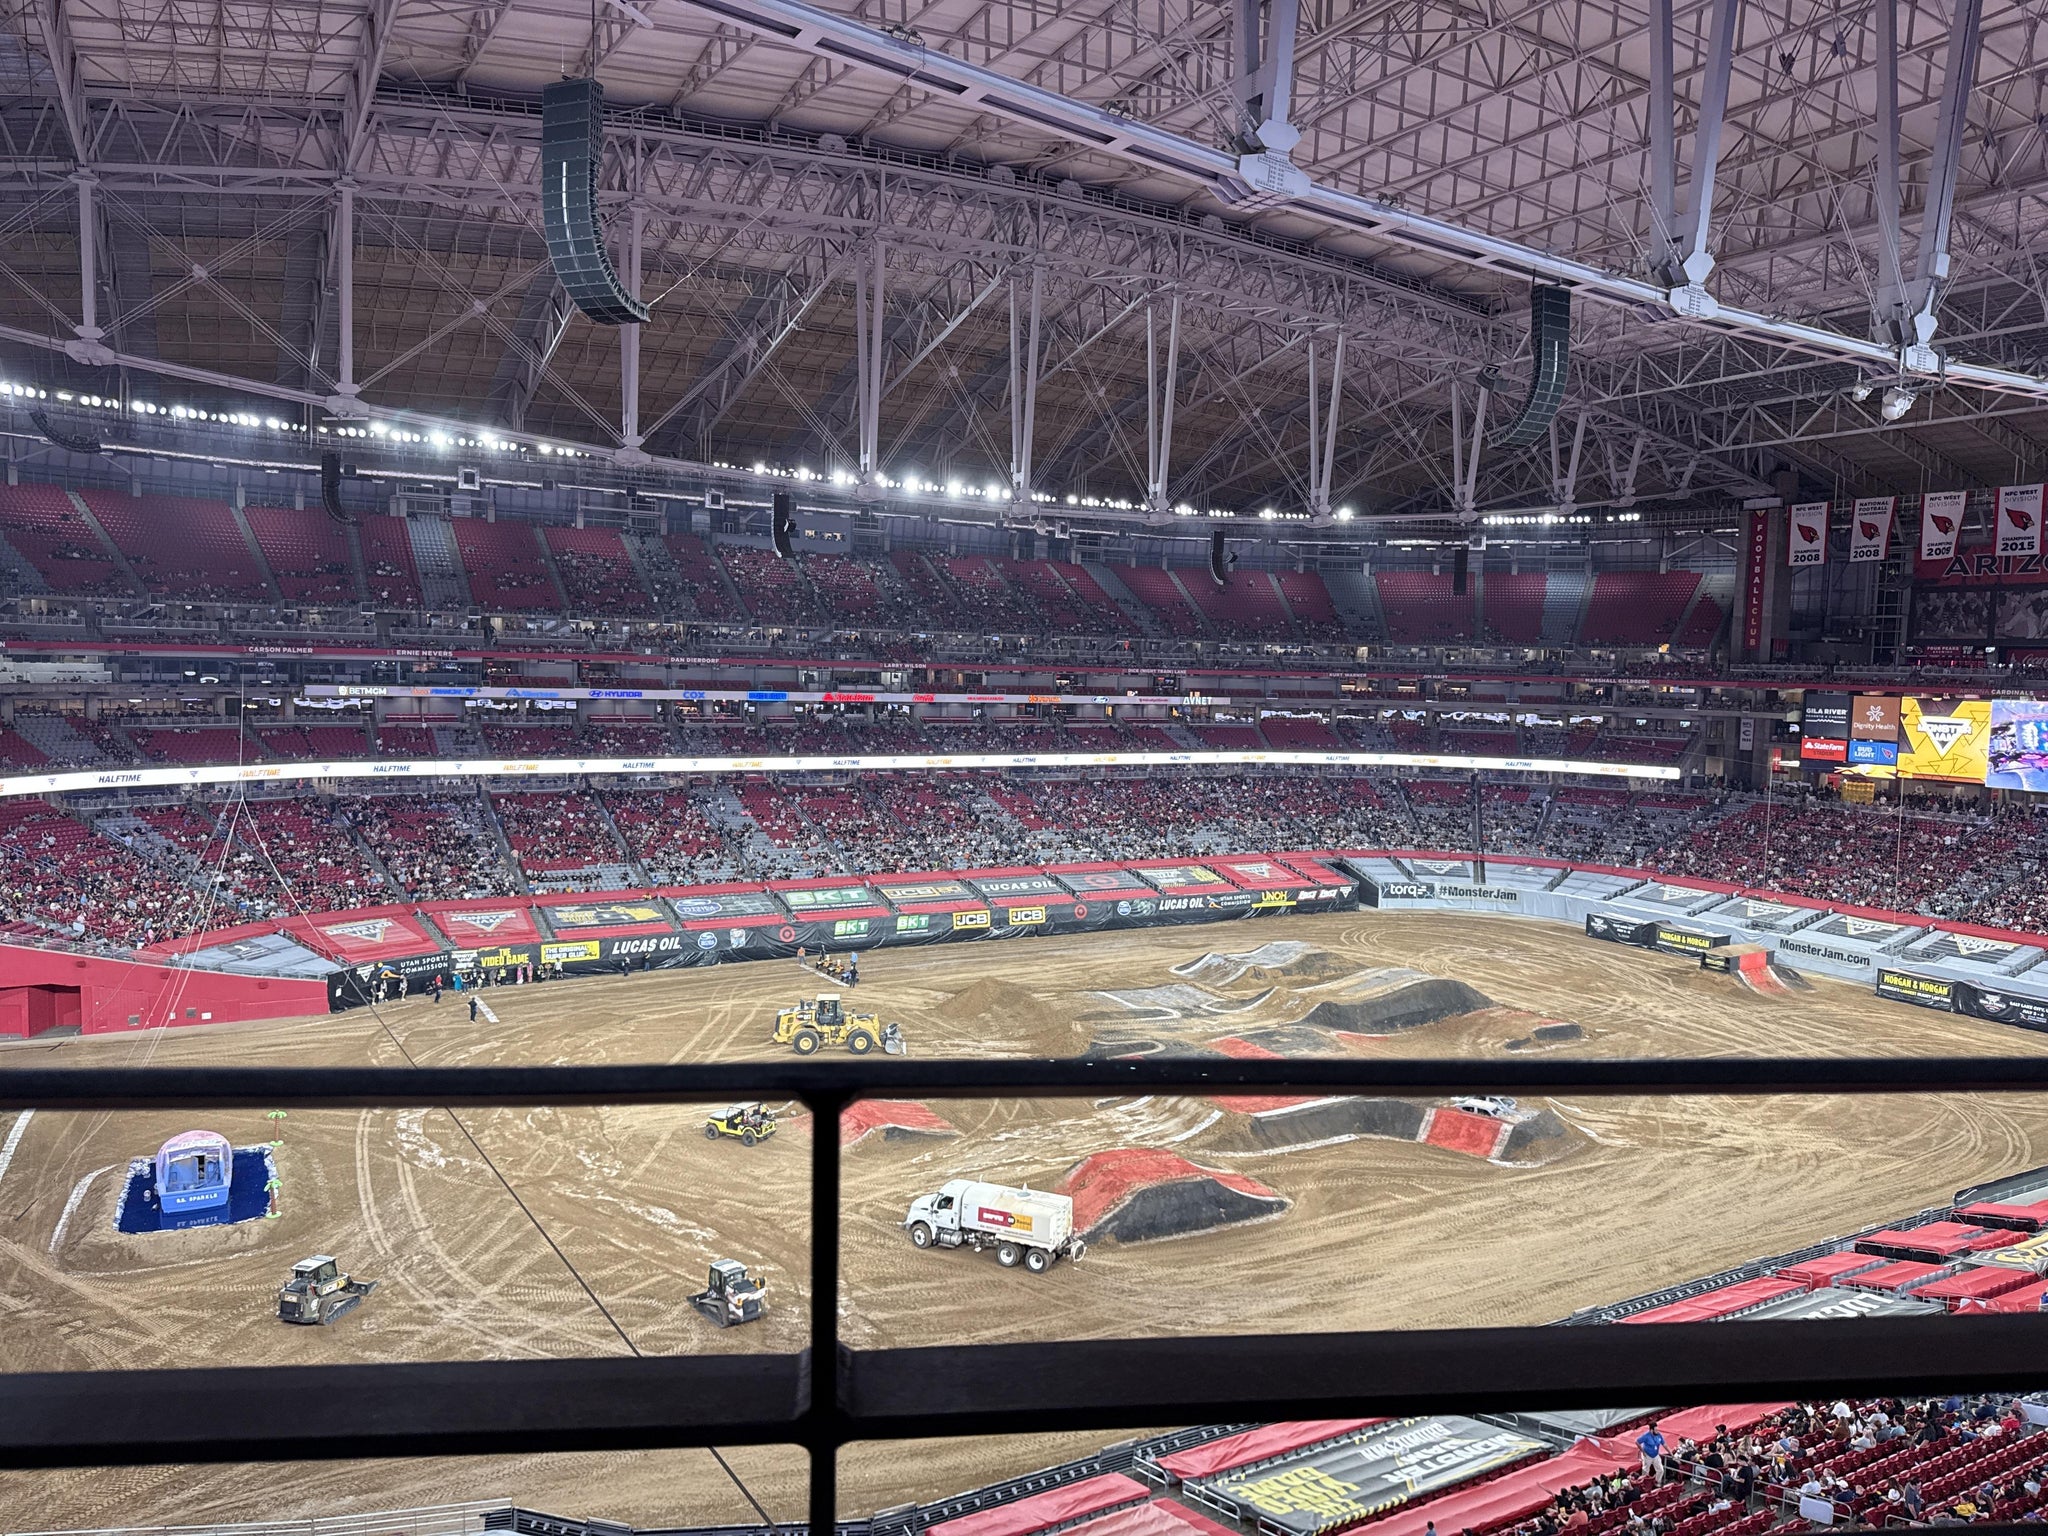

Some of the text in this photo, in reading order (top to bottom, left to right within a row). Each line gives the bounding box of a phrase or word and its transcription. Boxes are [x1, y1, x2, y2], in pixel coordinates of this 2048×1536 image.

[1928, 500, 1960, 508] DIVISION
[2004, 495, 2038, 503] DIVISION
[1926, 547, 1952, 557] 2009
[2000, 541, 2035, 552] 2015
[1793, 554, 1820, 563] 2008
[1852, 550, 1880, 559] 2008
[1752, 524, 1764, 604] FOOTBALL
[1749, 608, 1758, 646] CLUB
[248, 646, 281, 654] CARSON
[1182, 697, 1212, 705] AVNET
[1824, 708, 1846, 716] RIVER
[1854, 722, 1874, 731] Dignity
[373, 764, 411, 773] HALFTIME
[98, 774, 142, 784] HALFTIME
[890, 888, 934, 897] JCB
[981, 880, 1056, 893] LUCAS OIL
[788, 889, 865, 904] BKT
[1262, 890, 1288, 902] UNOH
[1438, 886, 1517, 901] #MonsterJam
[1159, 898, 1204, 911] LUCAS OIL
[450, 911, 517, 923] MONSTER
[956, 914, 988, 926] JCB
[1012, 910, 1043, 922] JCB
[836, 920, 868, 934] BKT
[897, 916, 929, 929] BKT
[325, 921, 393, 937] MONSTER
[612, 936, 682, 955] LUCAS OIL
[1658, 931, 1681, 944] MORGAN
[1687, 935, 1710, 948] MORGAN
[499, 948, 511, 956] THE
[558, 944, 588, 953] ORIGINAL
[1779, 938, 1871, 966] MonsterJam.com
[400, 955, 448, 968] UTAH SPORTS
[481, 954, 506, 968] VIDEO
[506, 954, 529, 966] GAME
[400, 962, 448, 974] COMMISSION
[1884, 974, 1948, 996] MORGAN & MORGAN
[189, 1193, 218, 1202] SPARKLE
[1381, 1432, 1524, 1484] MONSTER
[1400, 1439, 1466, 1466] JAM
[1226, 1466, 1330, 1502] GAME
[1254, 1478, 1361, 1515] VIDEO
[1314, 1498, 1365, 1519] THE
